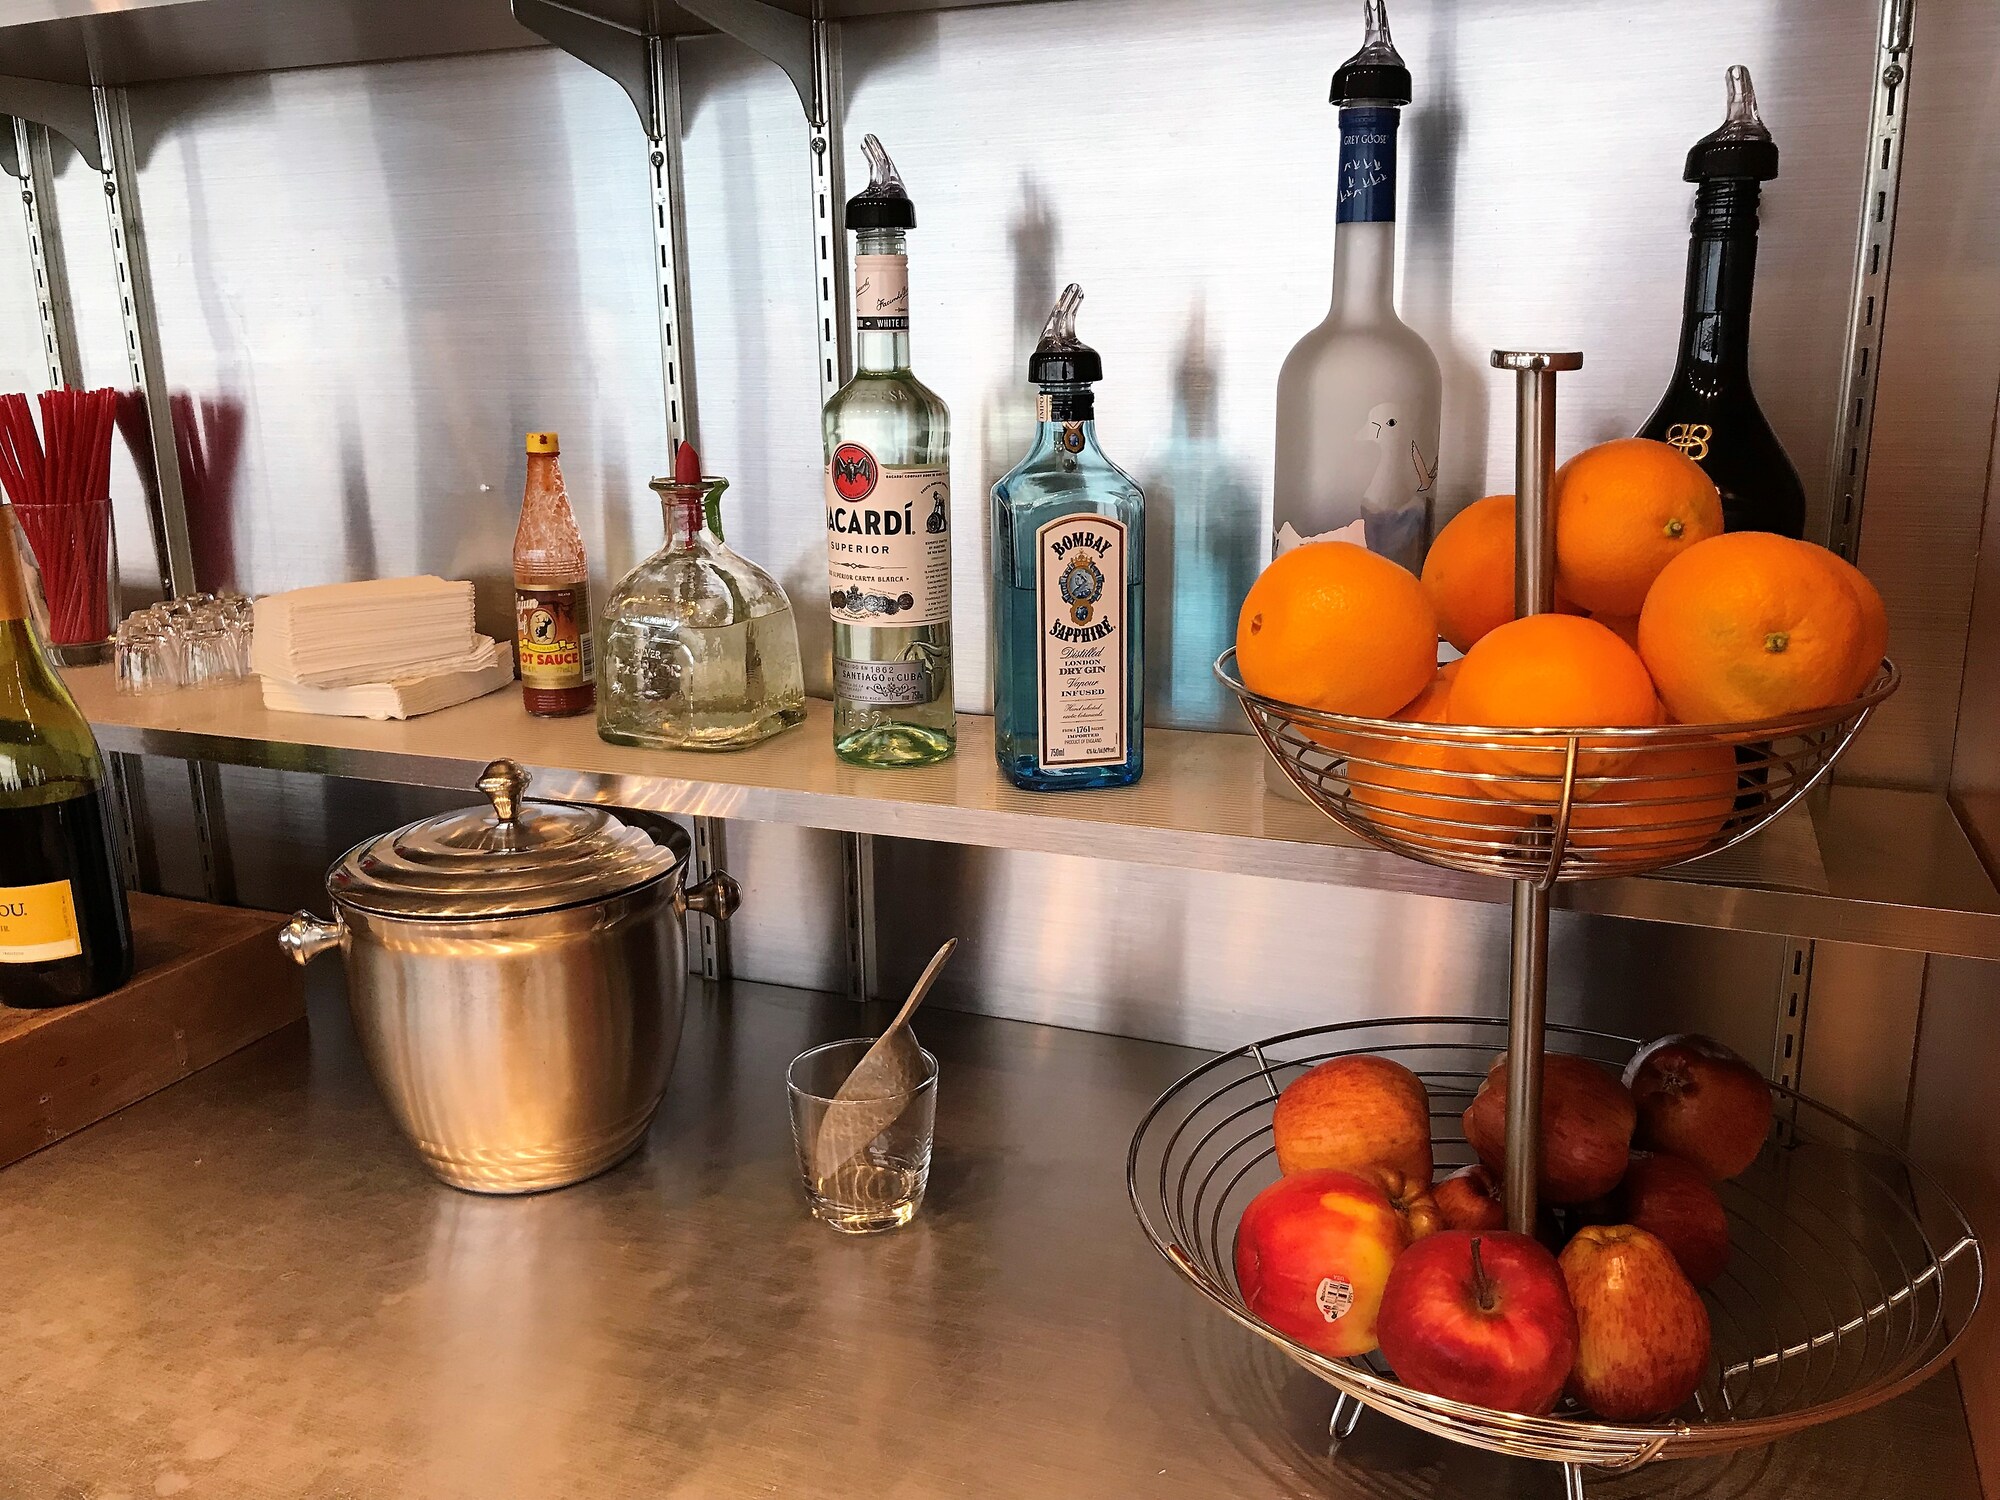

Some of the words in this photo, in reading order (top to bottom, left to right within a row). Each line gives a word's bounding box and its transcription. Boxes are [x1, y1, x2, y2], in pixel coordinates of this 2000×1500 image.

[1344, 135, 1359, 145] GREY
[1361, 133, 1387, 144] GOOSE
[877, 319, 899, 328] WHITE
[827, 500, 913, 535] ACARDÍ
[830, 541, 890, 555] SUPERIOR
[1051, 531, 1113, 560] BOMBAY
[855, 574, 875, 582] CARTA
[1049, 615, 1114, 643] SAPPHIRE
[1060, 646, 1106, 659] Distilled
[522, 653, 534, 665] OT
[537, 652, 579, 666] SAUCE
[842, 670, 885, 682] SANTIAGO
[896, 672, 923, 682] CUBA
[870, 666, 894, 674] 1862
[1059, 667, 1083, 675] DRY
[1084, 666, 1106, 674] GIN
[1066, 678, 1099, 690] Vapour
[1061, 688, 1105, 697] INFUSED
[1076, 725, 1091, 734] 1761
[1050, 748, 1065, 757] 750ml
